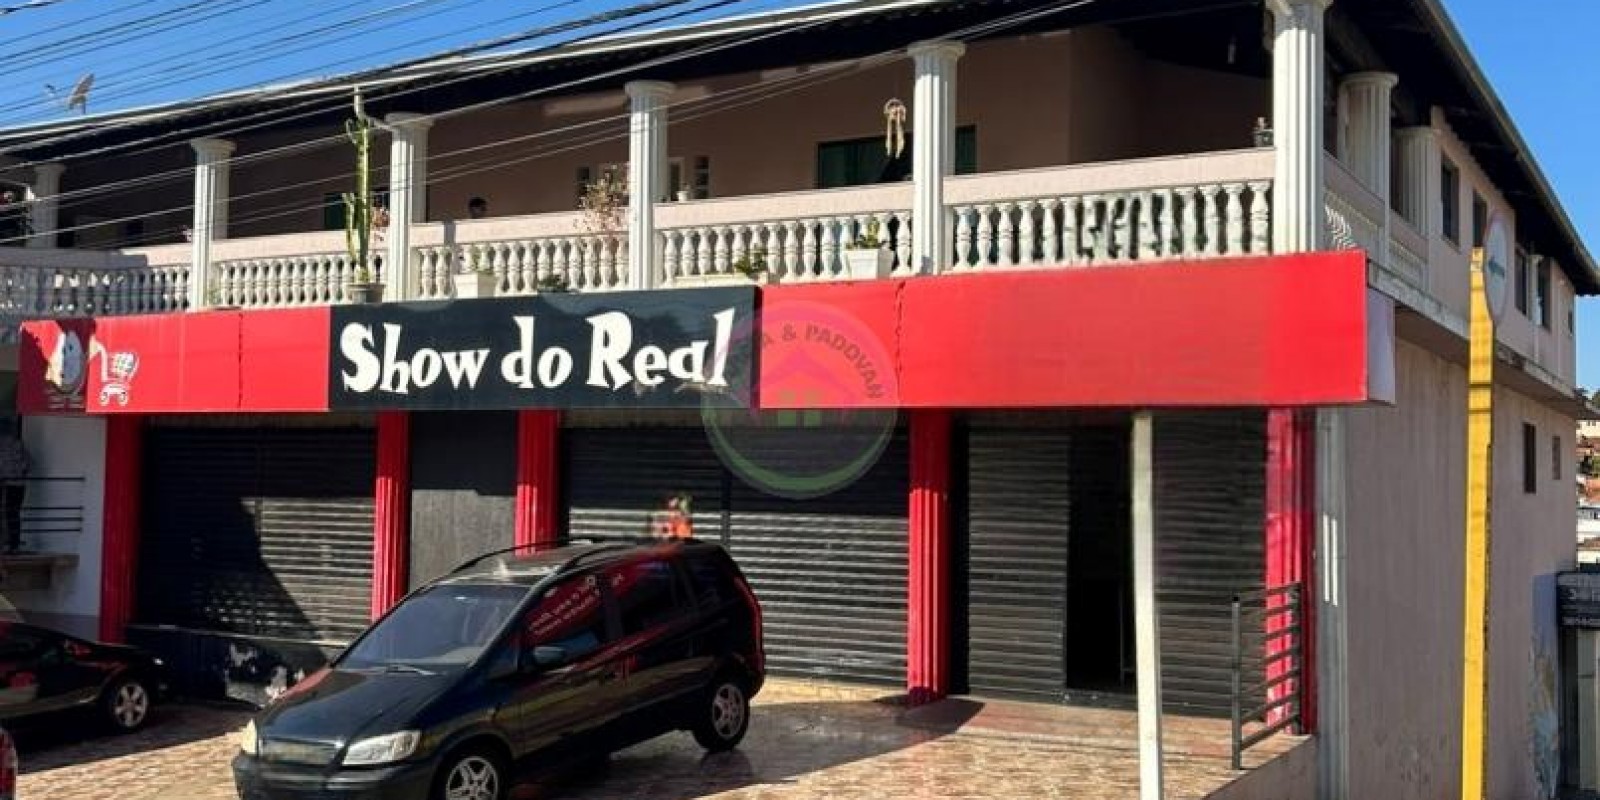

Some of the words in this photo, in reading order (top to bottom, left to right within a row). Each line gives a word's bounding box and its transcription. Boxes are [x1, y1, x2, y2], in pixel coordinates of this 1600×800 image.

[340, 322, 490, 394] Show
[500, 315, 573, 389] do
[586, 307, 736, 391] Real
